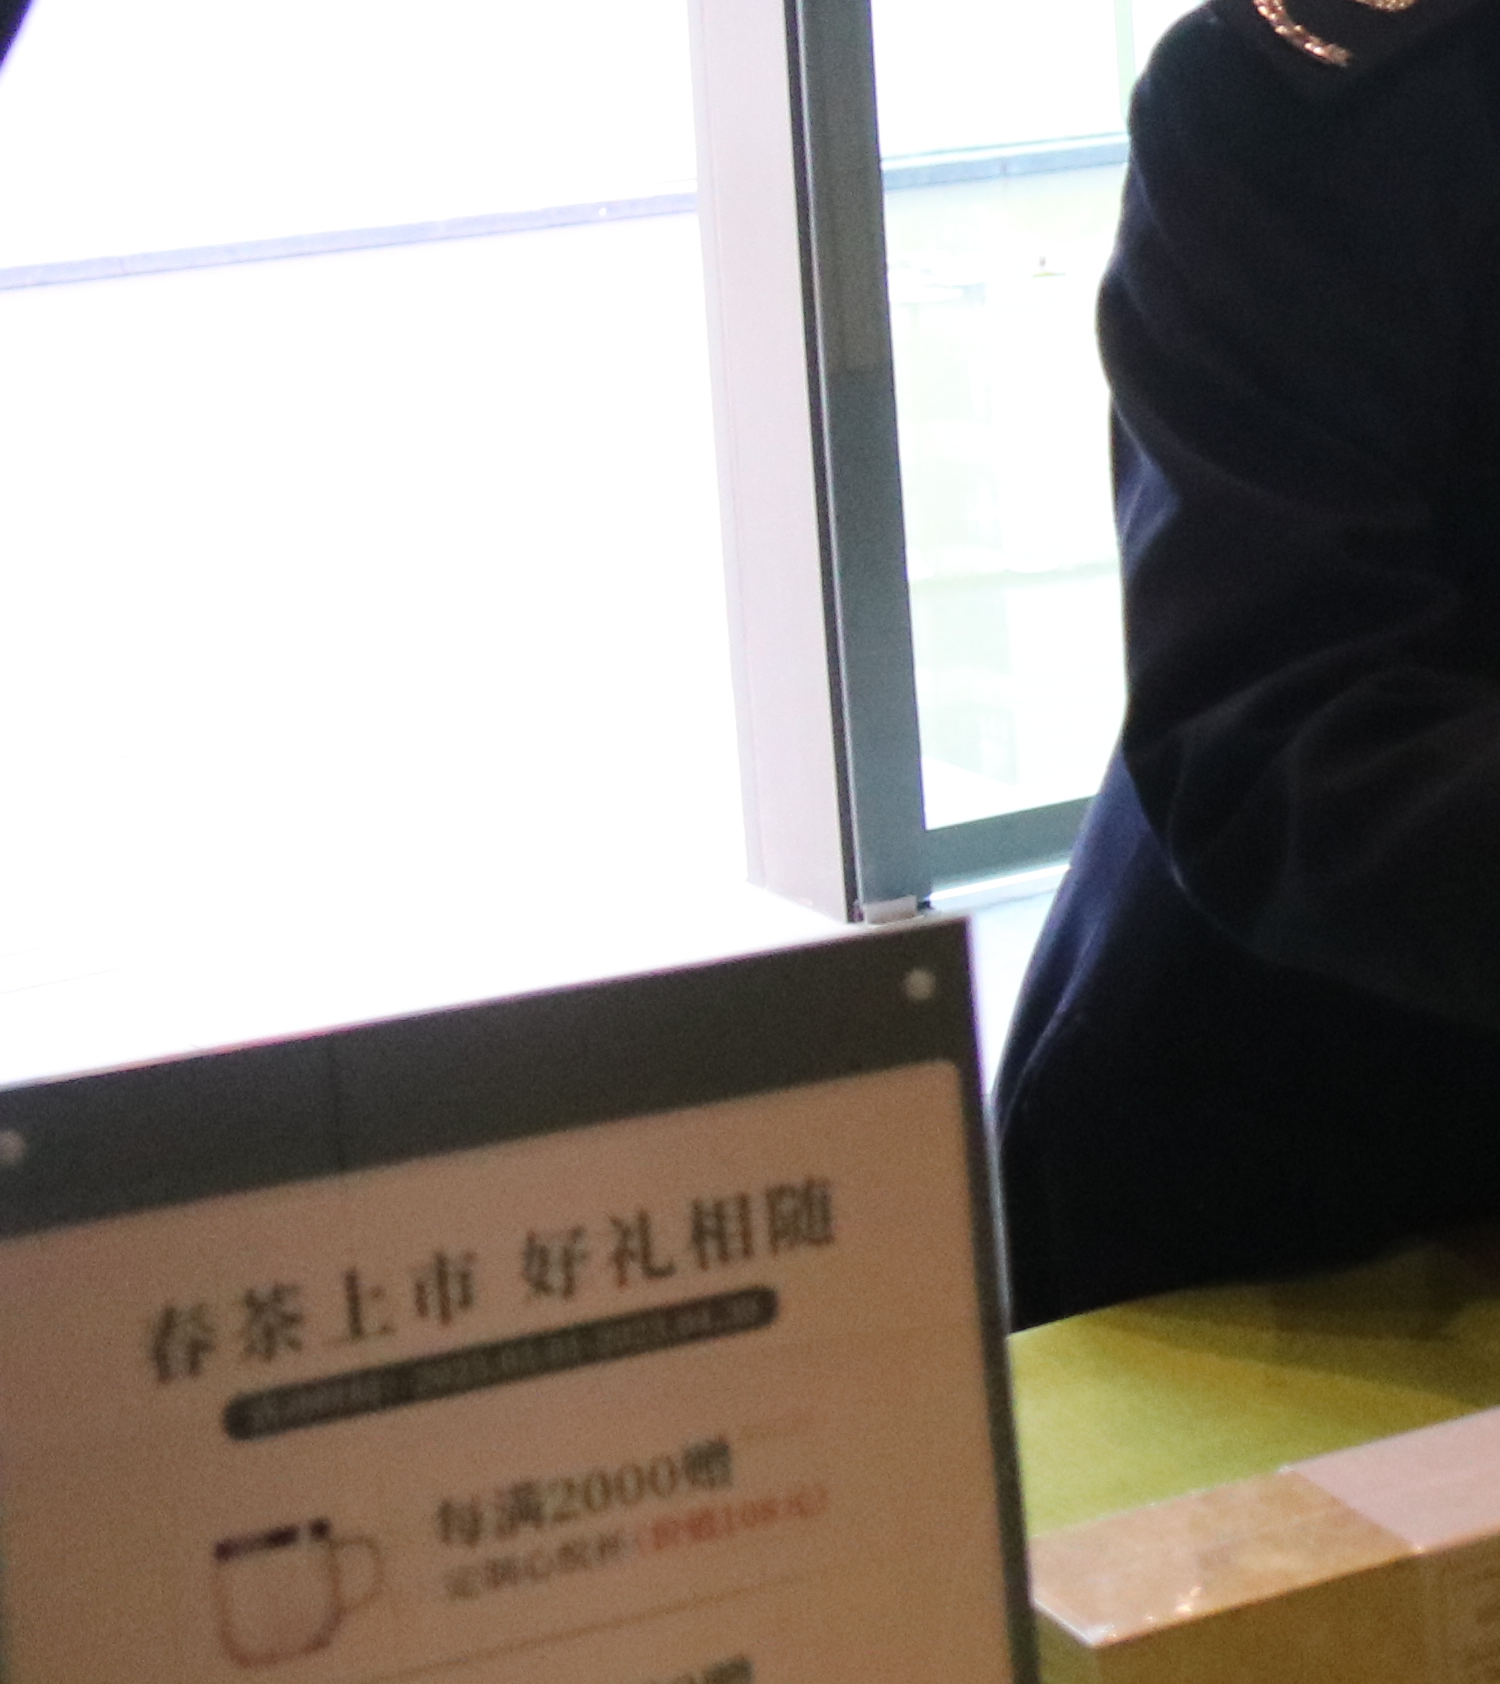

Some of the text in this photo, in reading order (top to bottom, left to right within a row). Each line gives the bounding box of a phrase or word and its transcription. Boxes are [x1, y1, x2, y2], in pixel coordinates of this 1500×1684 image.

[146, 1177, 834, 1382] 春茶上市 好礼相随
